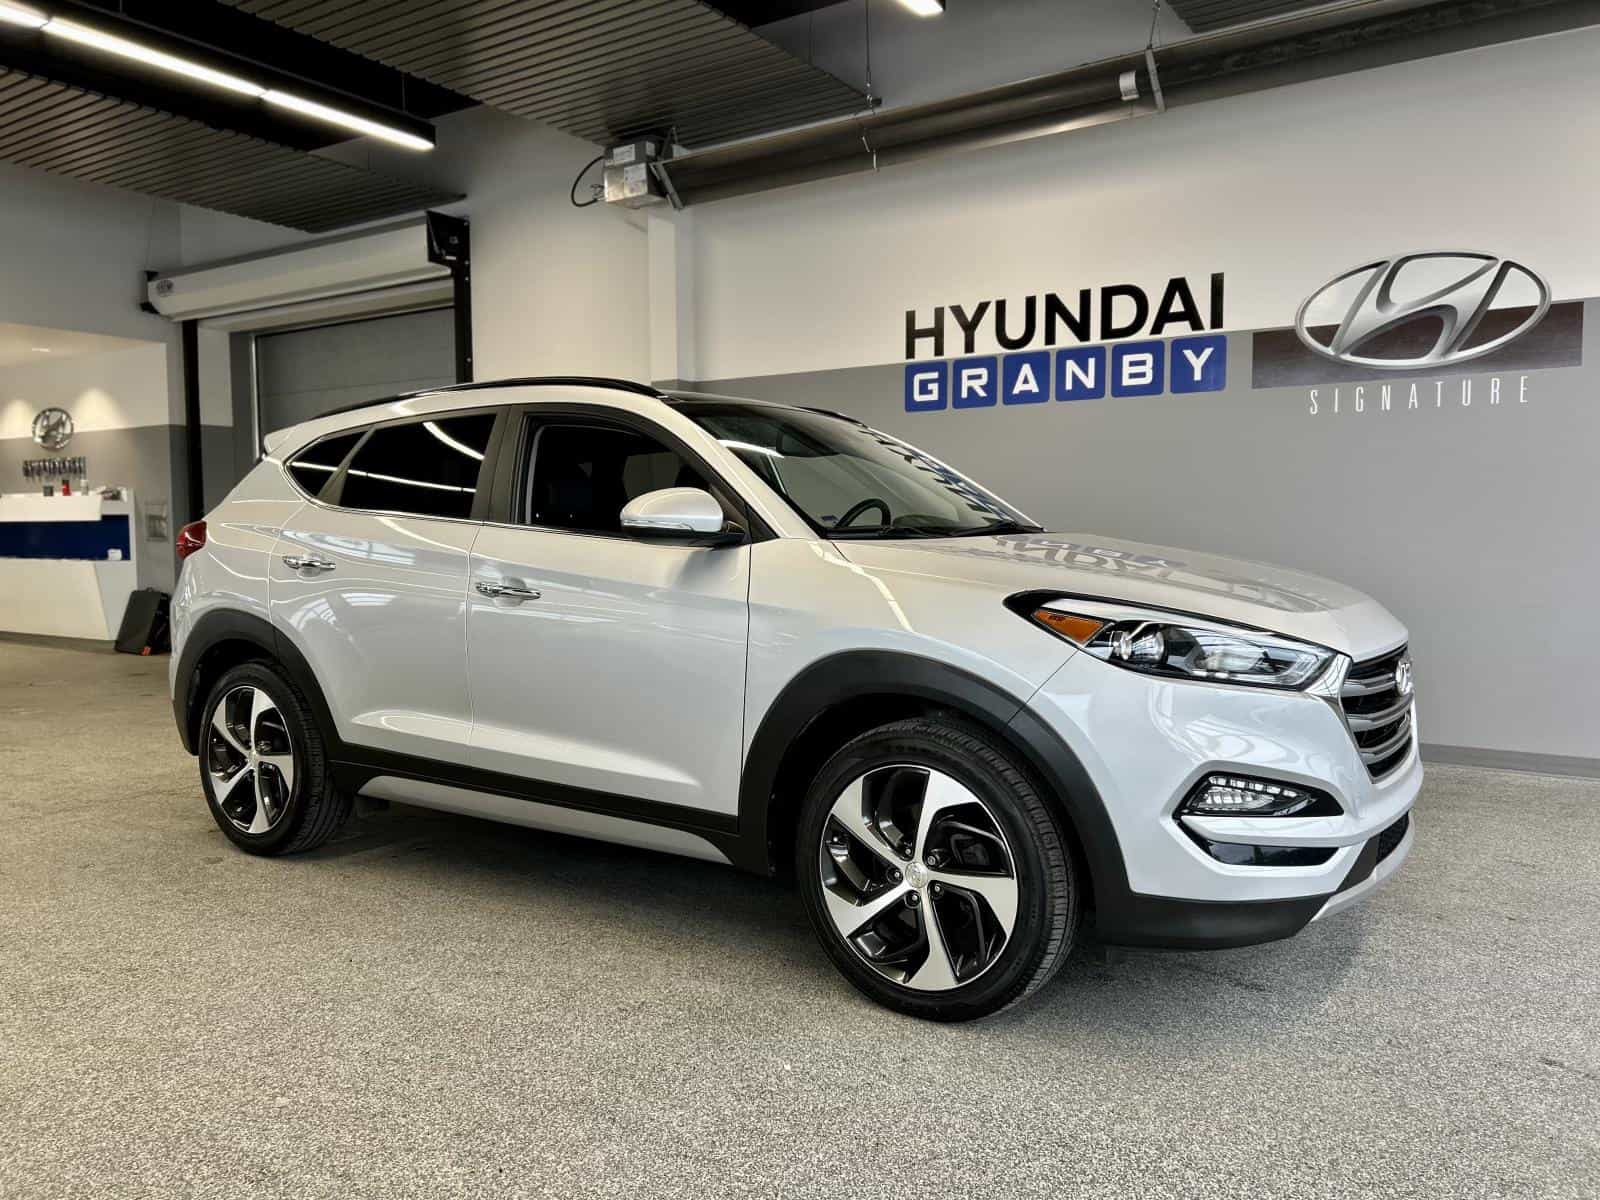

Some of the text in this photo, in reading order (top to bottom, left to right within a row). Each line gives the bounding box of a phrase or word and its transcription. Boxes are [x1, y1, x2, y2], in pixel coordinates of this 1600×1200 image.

[905, 272, 1225, 360] HYUNDAI
[912, 346, 1215, 402] GRANBY
[1309, 376, 1529, 415] SIGNATURE
